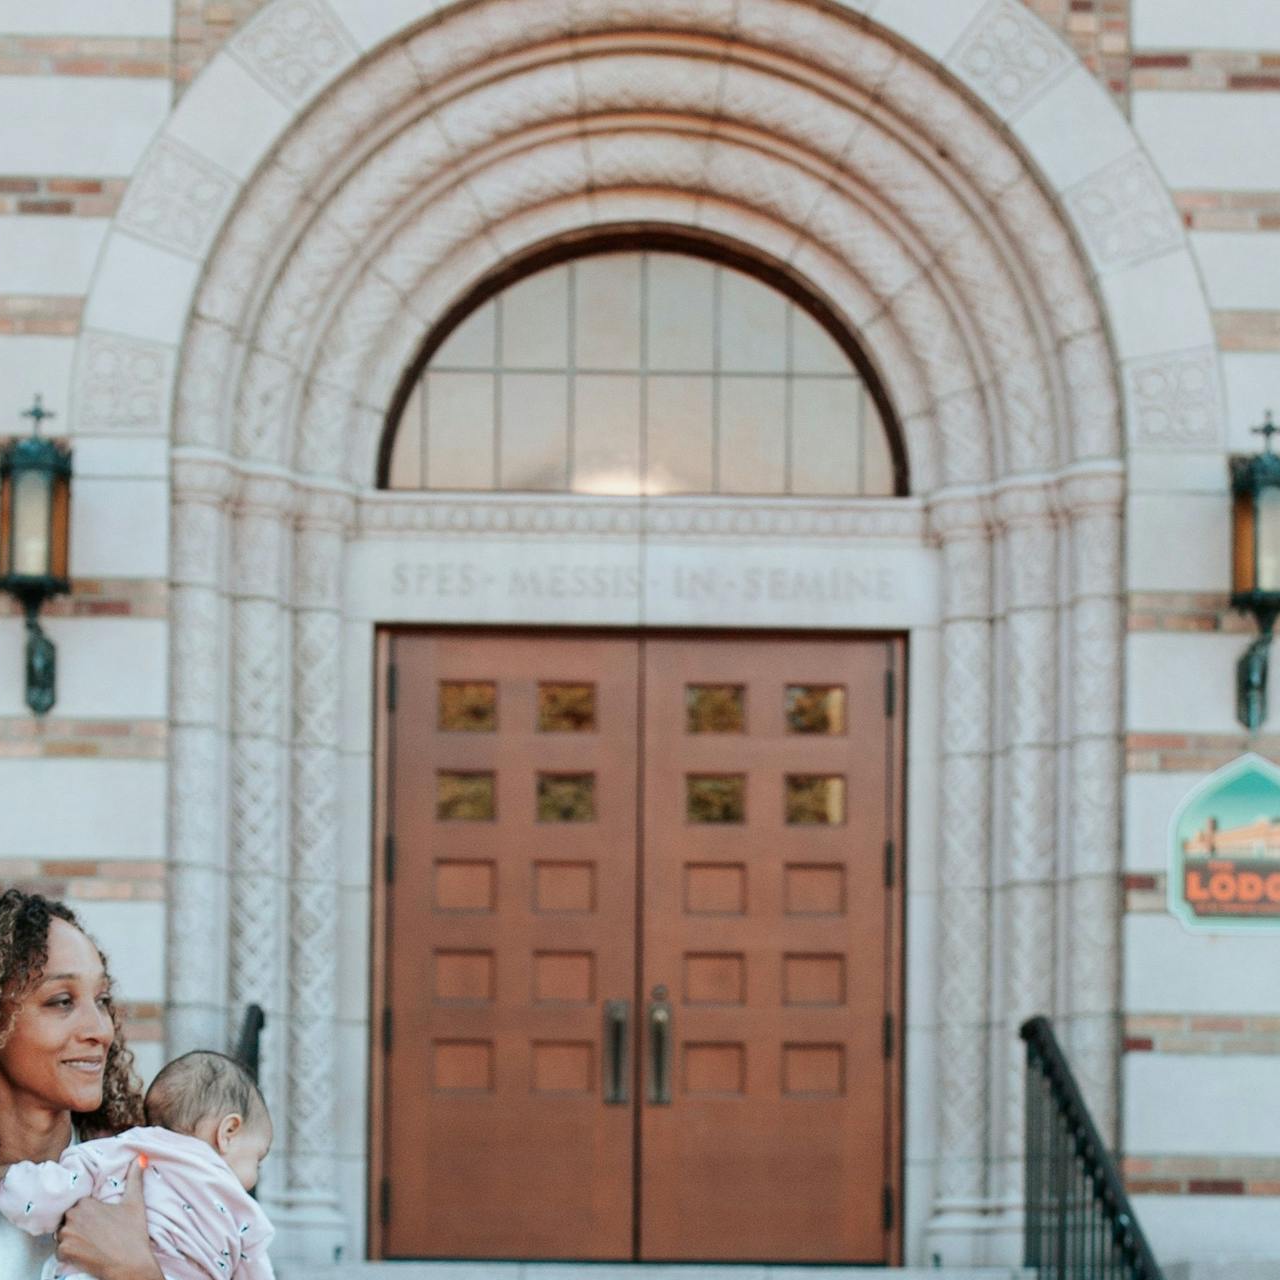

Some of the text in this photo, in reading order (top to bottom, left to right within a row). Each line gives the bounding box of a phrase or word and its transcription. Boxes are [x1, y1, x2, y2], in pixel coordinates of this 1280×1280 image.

[391, 562, 896, 602] SPES MESSIS IN SEMINE
